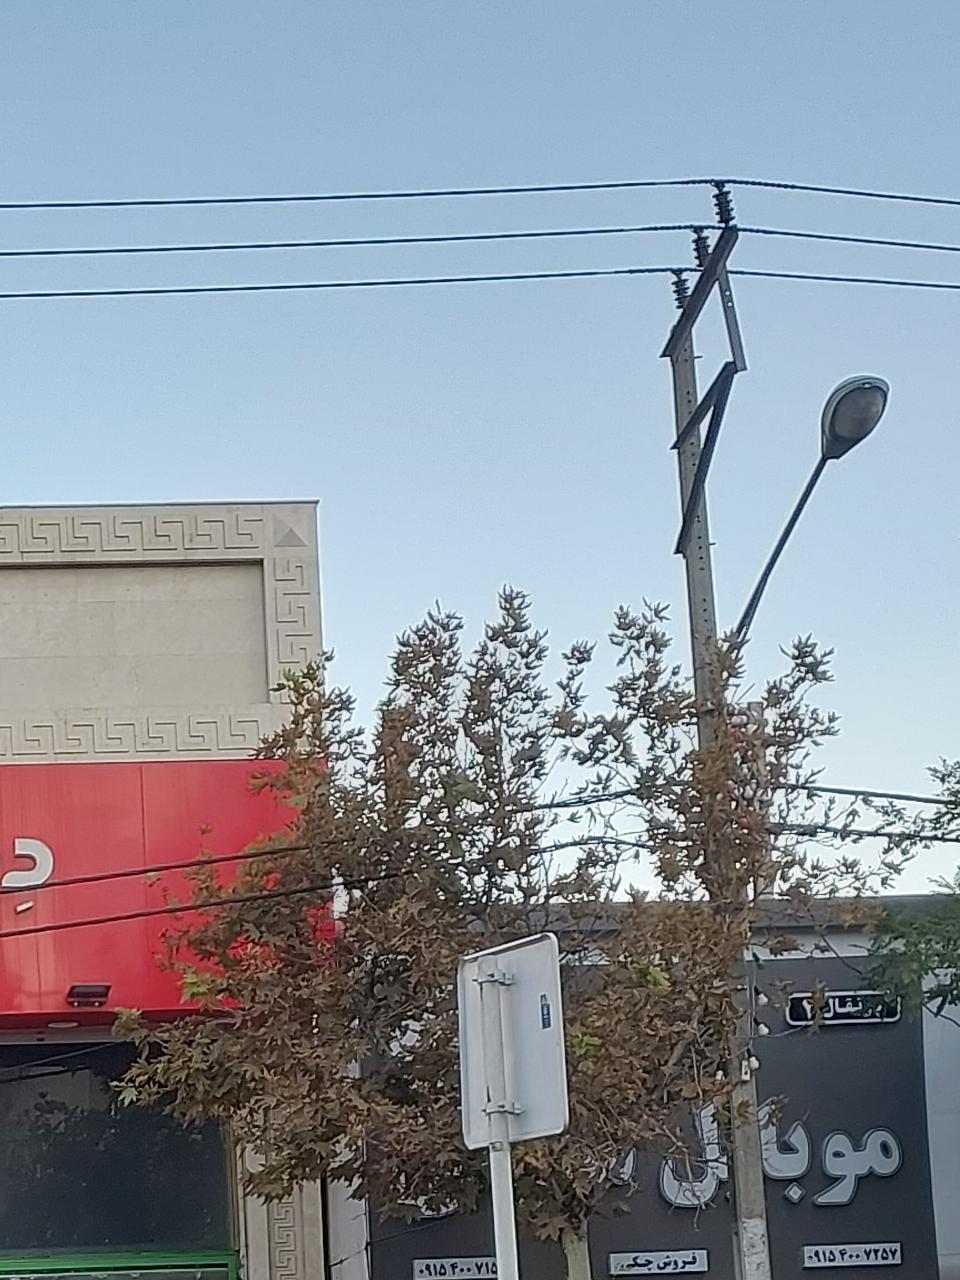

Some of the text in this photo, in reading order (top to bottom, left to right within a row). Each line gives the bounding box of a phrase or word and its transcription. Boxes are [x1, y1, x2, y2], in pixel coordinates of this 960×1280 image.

[660, 1099, 902, 1207] موبال
[656, 1252, 697, 1270] فروش
[807, 1247, 899, 1265] ۰۹۱۵ ۴۰۰ ۷۲۵۷
[418, 1263, 447, 1277] ۰۹۱۵
[450, 1262, 472, 1275] ۴۰۰
